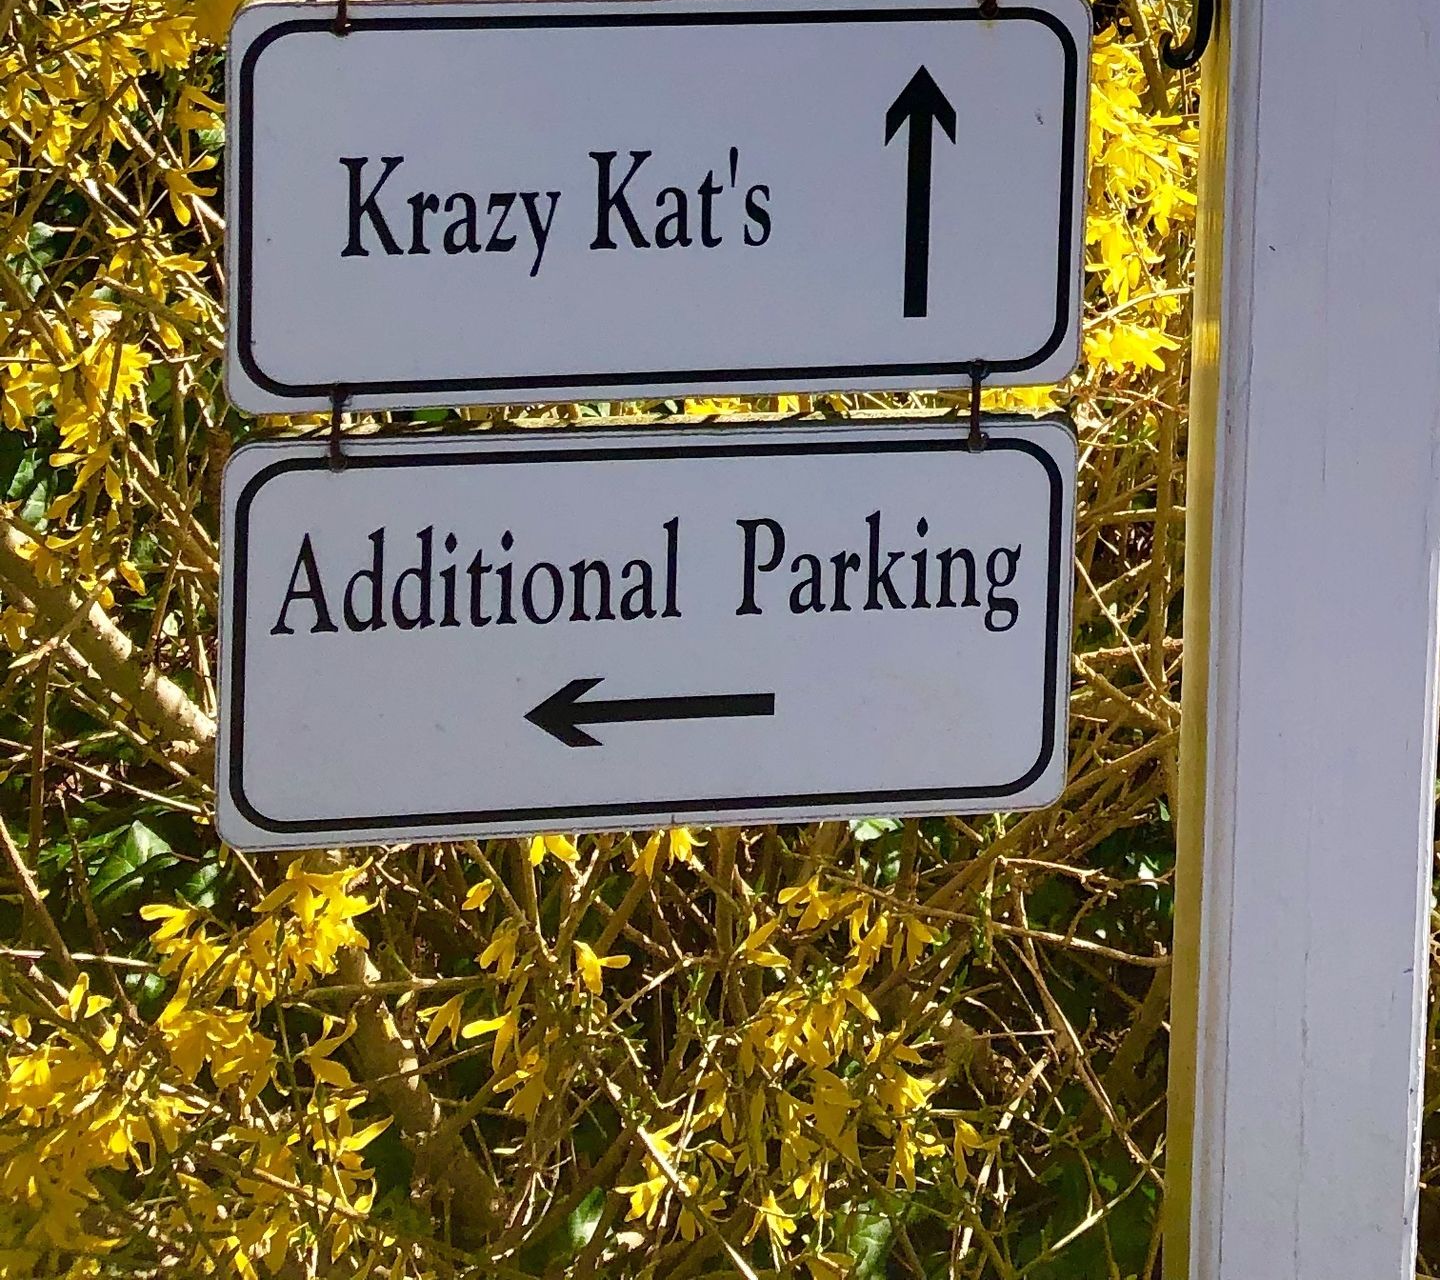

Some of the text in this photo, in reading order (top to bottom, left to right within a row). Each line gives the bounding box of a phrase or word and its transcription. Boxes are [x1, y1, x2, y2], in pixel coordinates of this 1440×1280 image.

[338, 146, 772, 278] Krazy Kat's
[269, 509, 1022, 636] Additional Parking
